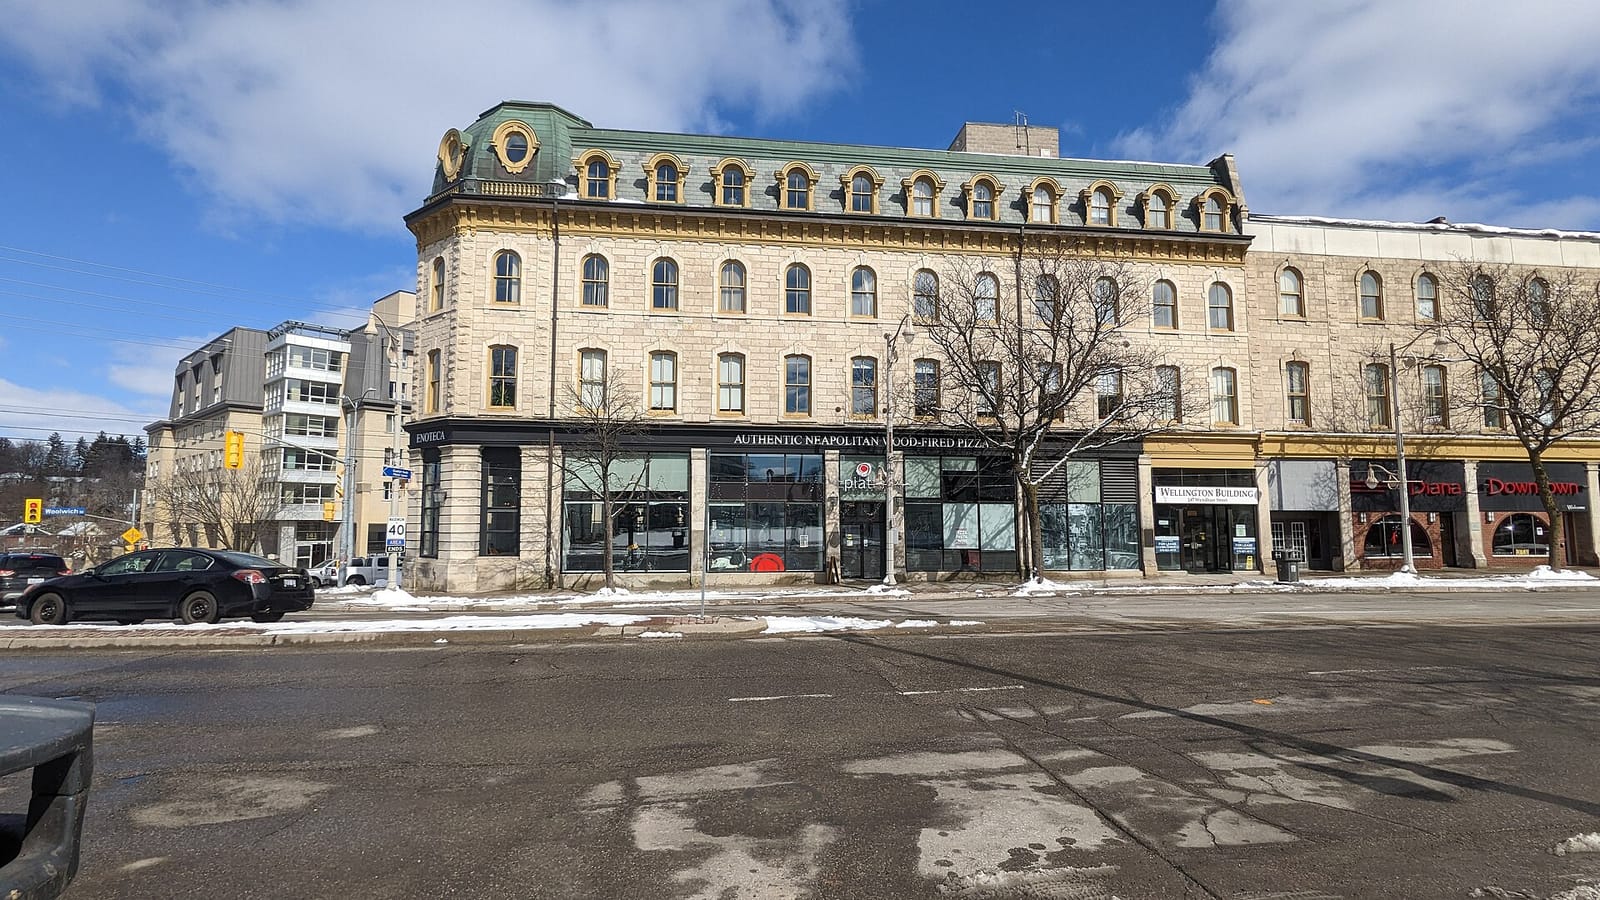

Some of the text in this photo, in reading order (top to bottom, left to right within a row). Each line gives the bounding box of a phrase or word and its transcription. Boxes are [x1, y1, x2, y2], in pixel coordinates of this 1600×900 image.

[416, 431, 445, 443] ENOTECA
[734, 434, 803, 445] AUTHENTIC
[805, 435, 879, 446] NEAPOLITAN
[957, 437, 989, 448] PIZZA
[1160, 487, 1254, 498] WELLINGTON BUILDING
[1410, 480, 1462, 495] Diana
[1488, 477, 1579, 495] Downown
[388, 524, 405, 535] 40
